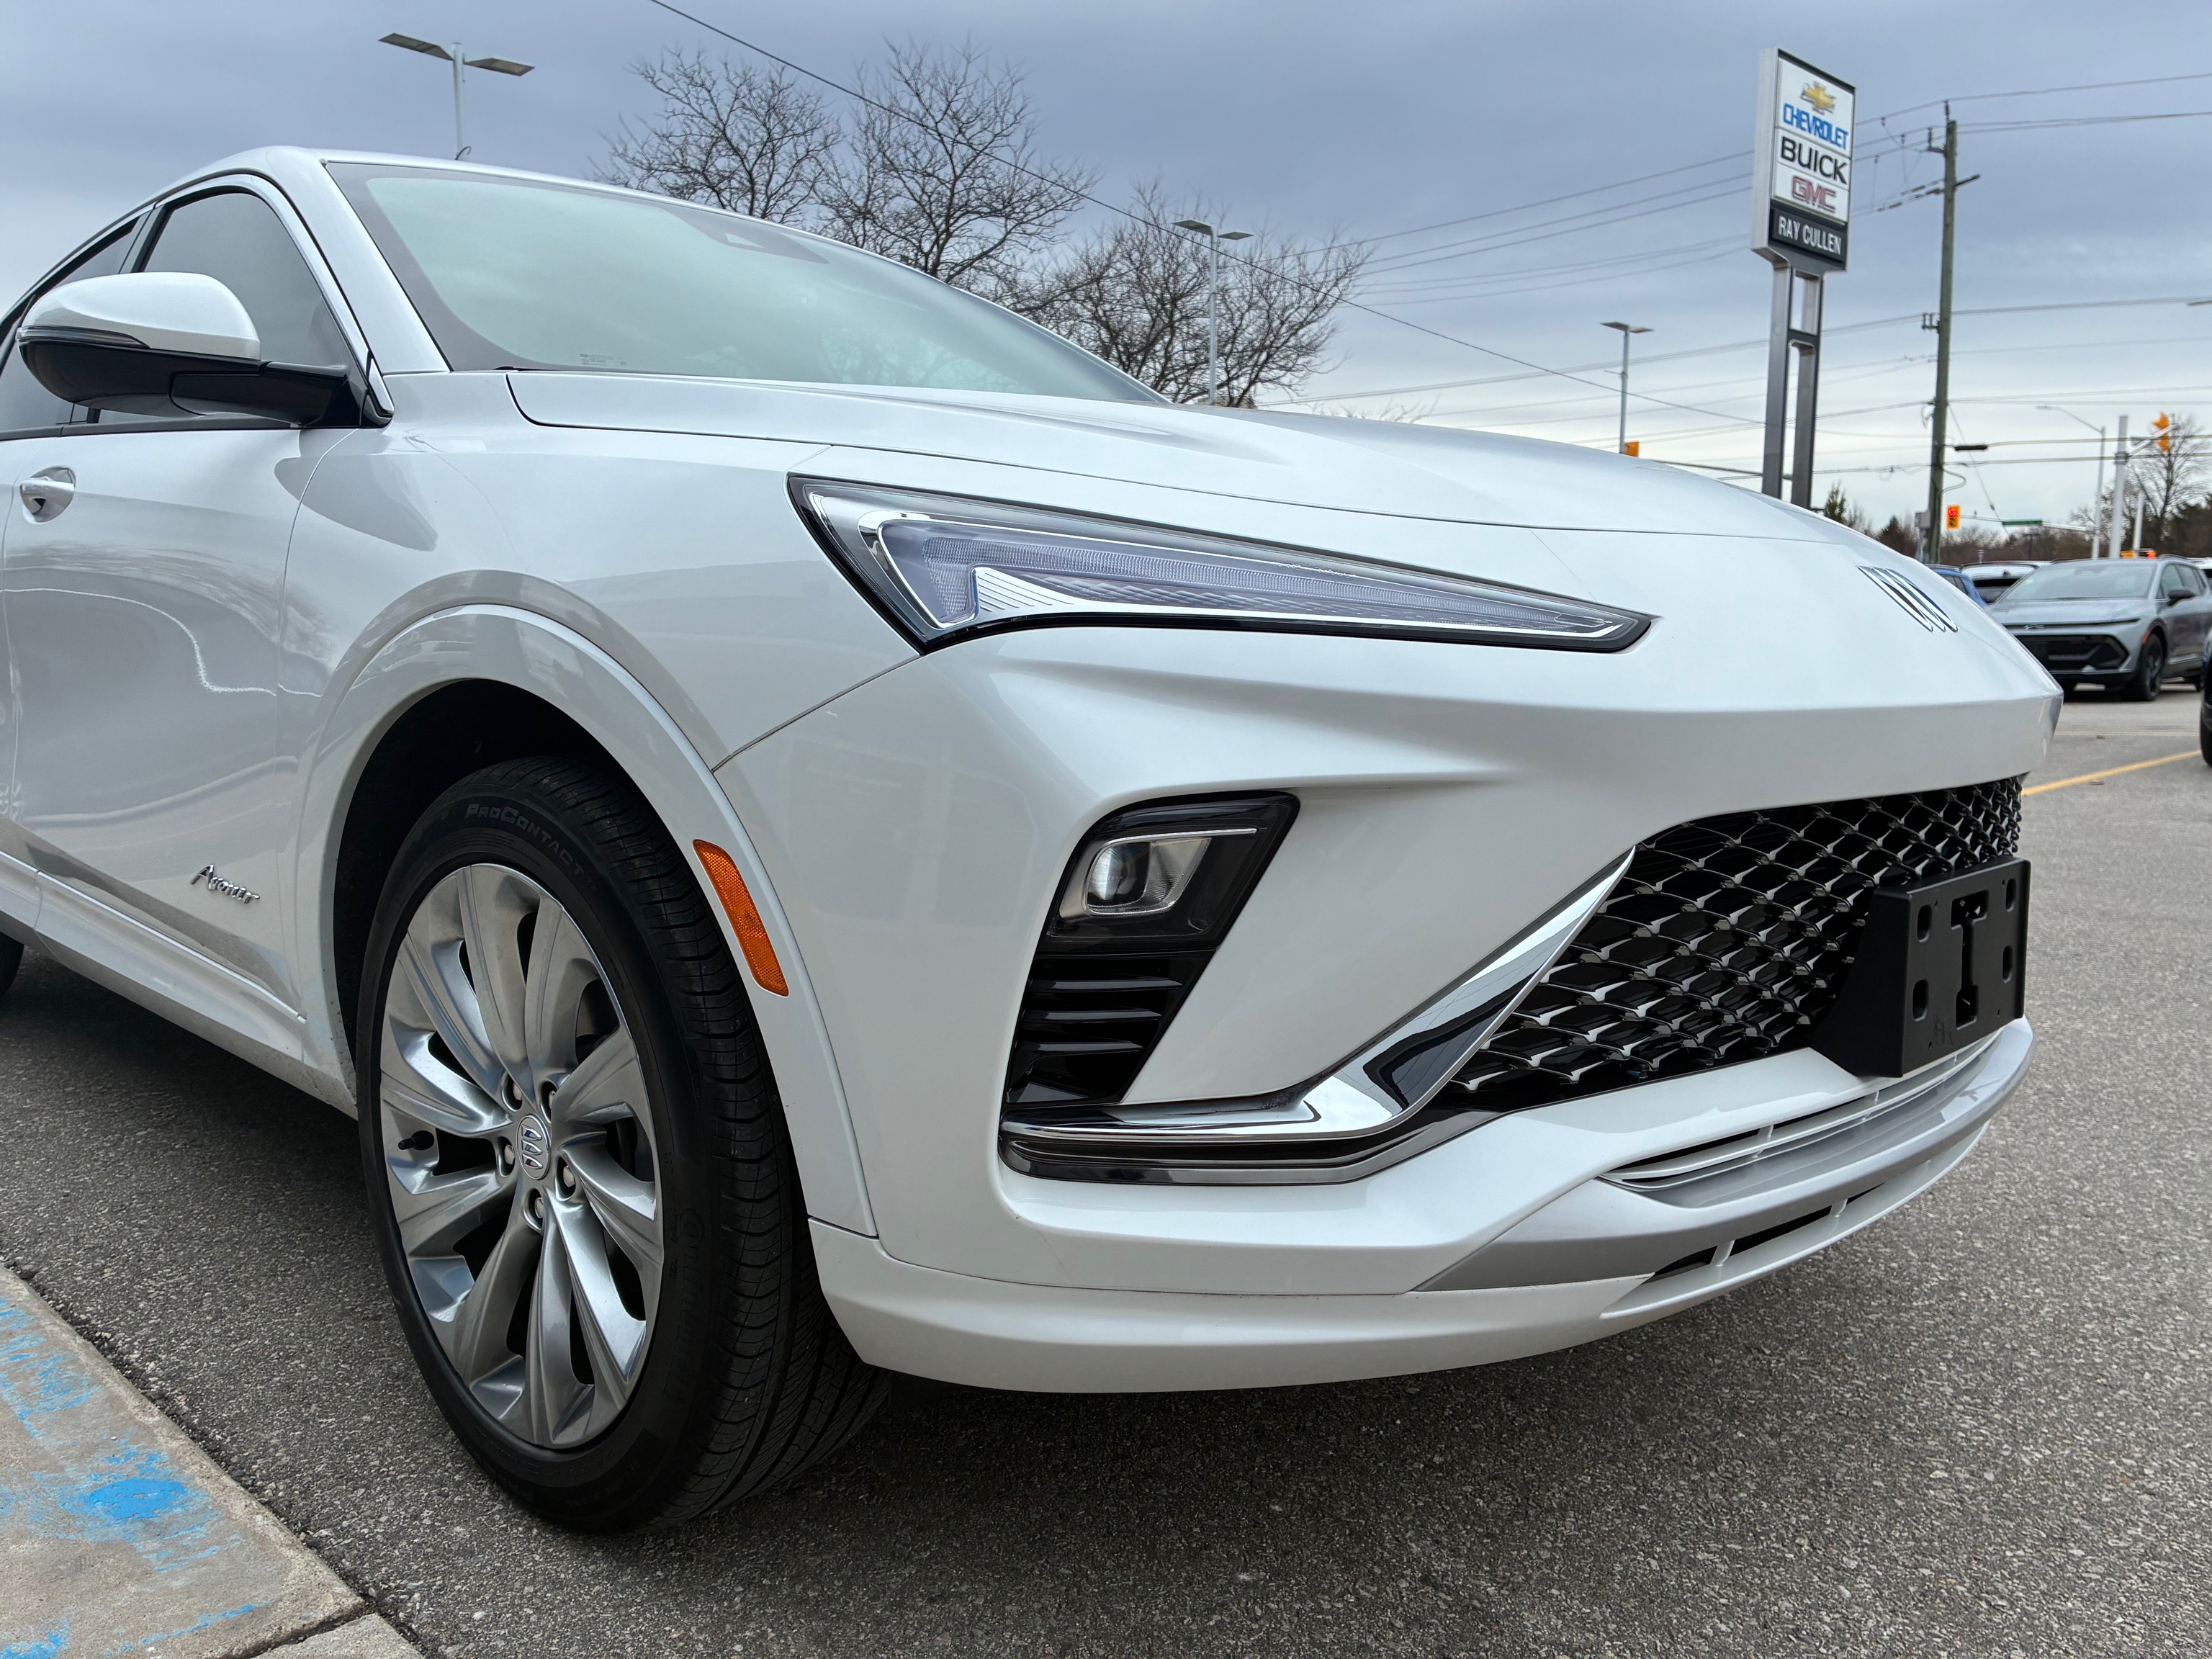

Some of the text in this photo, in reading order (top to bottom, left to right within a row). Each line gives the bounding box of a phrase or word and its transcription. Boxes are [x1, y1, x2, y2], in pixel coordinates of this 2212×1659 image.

[1783, 102, 1849, 150] CHEVROLET
[1781, 135, 1847, 185] BUICK
[1791, 175, 1837, 213] GMC
[1778, 215, 1842, 255] RAY CULLEN
